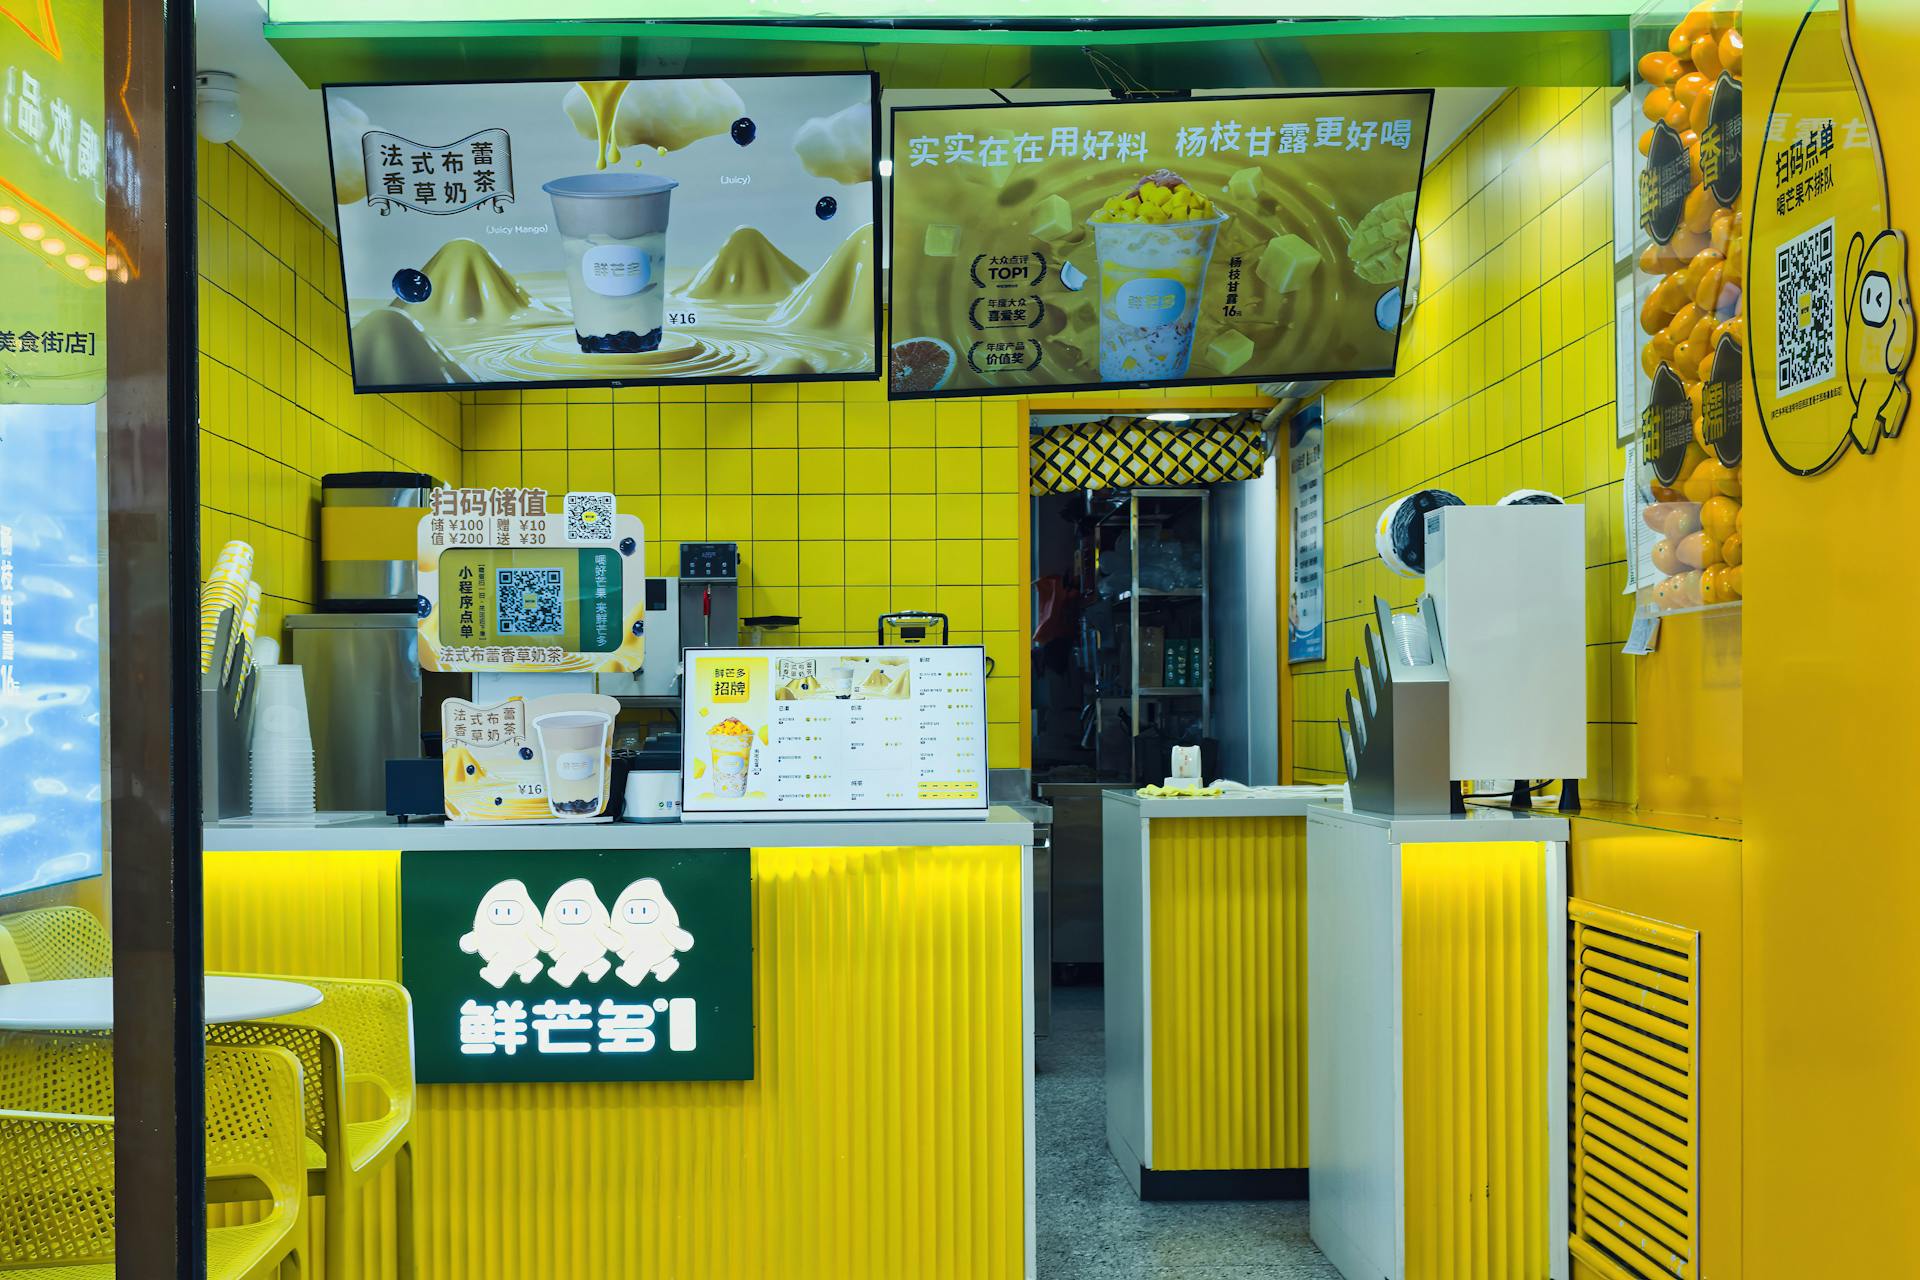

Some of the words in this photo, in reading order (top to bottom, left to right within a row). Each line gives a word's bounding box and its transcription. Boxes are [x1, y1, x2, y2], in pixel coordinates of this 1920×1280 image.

[909, 126, 1148, 167] 实实在在用好料
[1176, 117, 1412, 158] 杨枝甘露更好喝
[1702, 124, 1722, 187] 香
[1776, 120, 1834, 188] 扫码点单
[380, 142, 493, 174] 法式布蕾
[383, 170, 495, 204] 香草奶茶
[1777, 164, 1834, 216] 喝芒果不排队
[988, 267, 1028, 280] TOP1
[1227, 257, 1242, 304] 杨枝甘露
[669, 313, 696, 325] ¥16
[431, 487, 546, 517] 扫码储值
[459, 565, 474, 639] 小程序点单
[440, 646, 562, 663] 法式布蕾香草奶茶
[714, 668, 746, 679] 鲜芒多
[714, 681, 746, 697] 招牌
[453, 707, 516, 727] 法式布蕾
[454, 722, 517, 742] 香草奶茶
[518, 784, 542, 795] ¥16
[460, 998, 656, 1055] 鲜芒多
